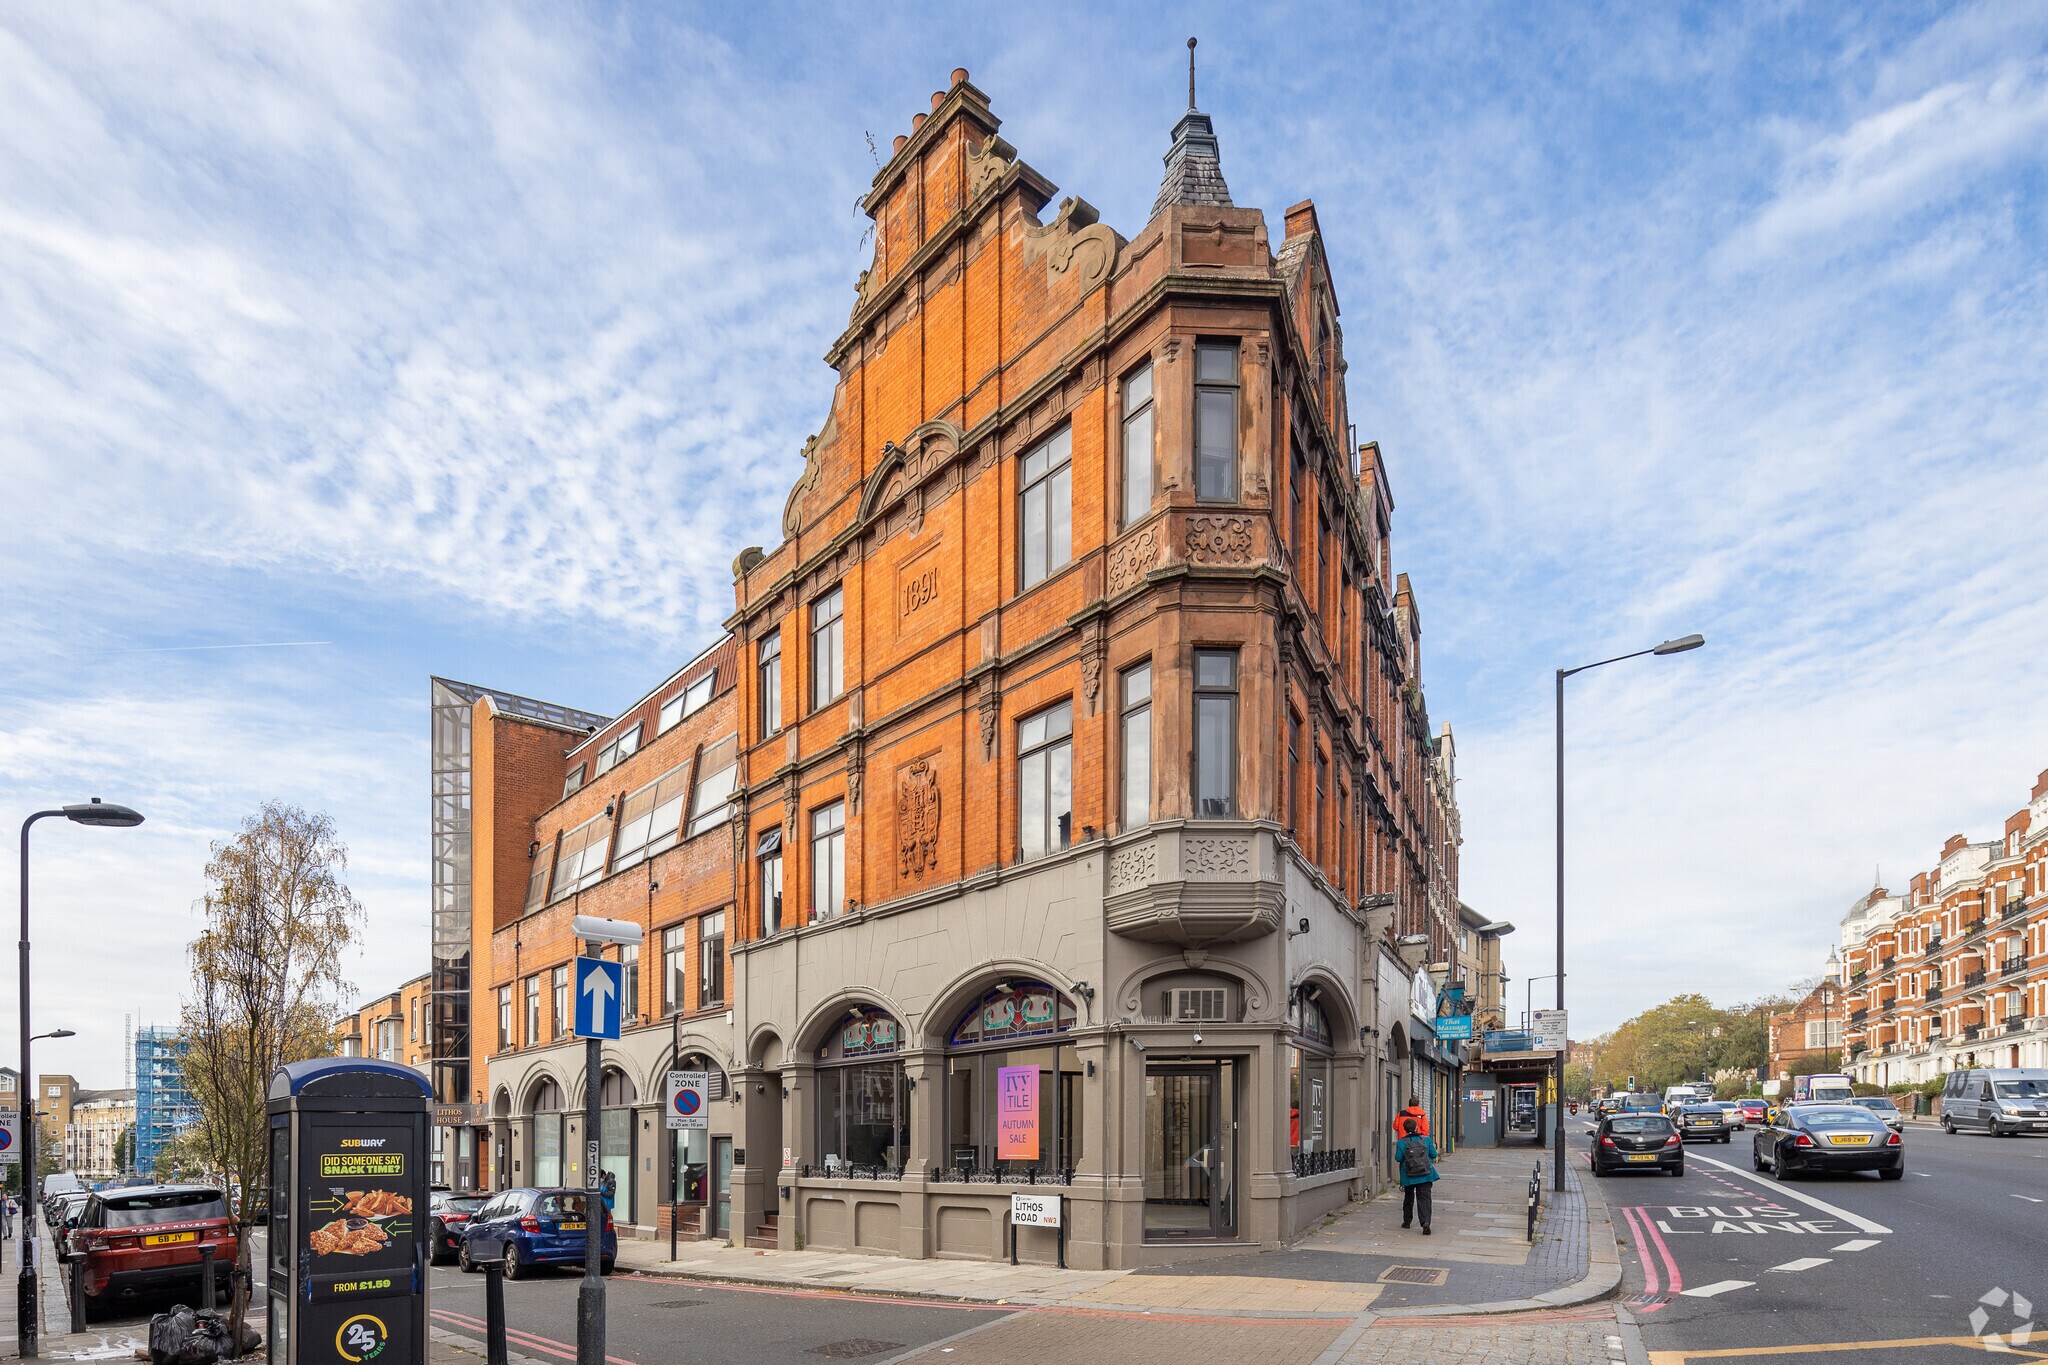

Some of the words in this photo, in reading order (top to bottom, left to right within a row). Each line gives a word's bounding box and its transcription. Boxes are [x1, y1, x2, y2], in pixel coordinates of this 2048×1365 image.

[902, 567, 938, 617] 1891
[1442, 1017, 1460, 1025] Thai
[1437, 1024, 1468, 1032] Massage
[1006, 1075, 1030, 1092] IVY
[1008, 1095, 1029, 1108] TILE
[437, 1108, 463, 1116] LITHOS
[1002, 1120, 1034, 1129] AUTUMN
[340, 1138, 386, 1148] SUBWAY
[1009, 1133, 1027, 1144] SALE
[324, 1156, 340, 1166] DID
[341, 1156, 384, 1166] SOMEONE
[384, 1155, 401, 1165] SAY
[323, 1165, 365, 1175] SNACK
[366, 1165, 401, 1174] TIME?
[1015, 1202, 1043, 1212] LITHOS
[1666, 1205, 1800, 1218] BUS
[1015, 1212, 1038, 1222] ROAD
[1043, 1216, 1057, 1224] NW3
[131, 1225, 167, 1233] RANGE
[1656, 1220, 1860, 1234] LANE
[333, 1282, 358, 1293] FROM
[359, 1279, 391, 1290] £1.59
[347, 1323, 376, 1352] 25
[363, 1341, 386, 1361] YEARS
